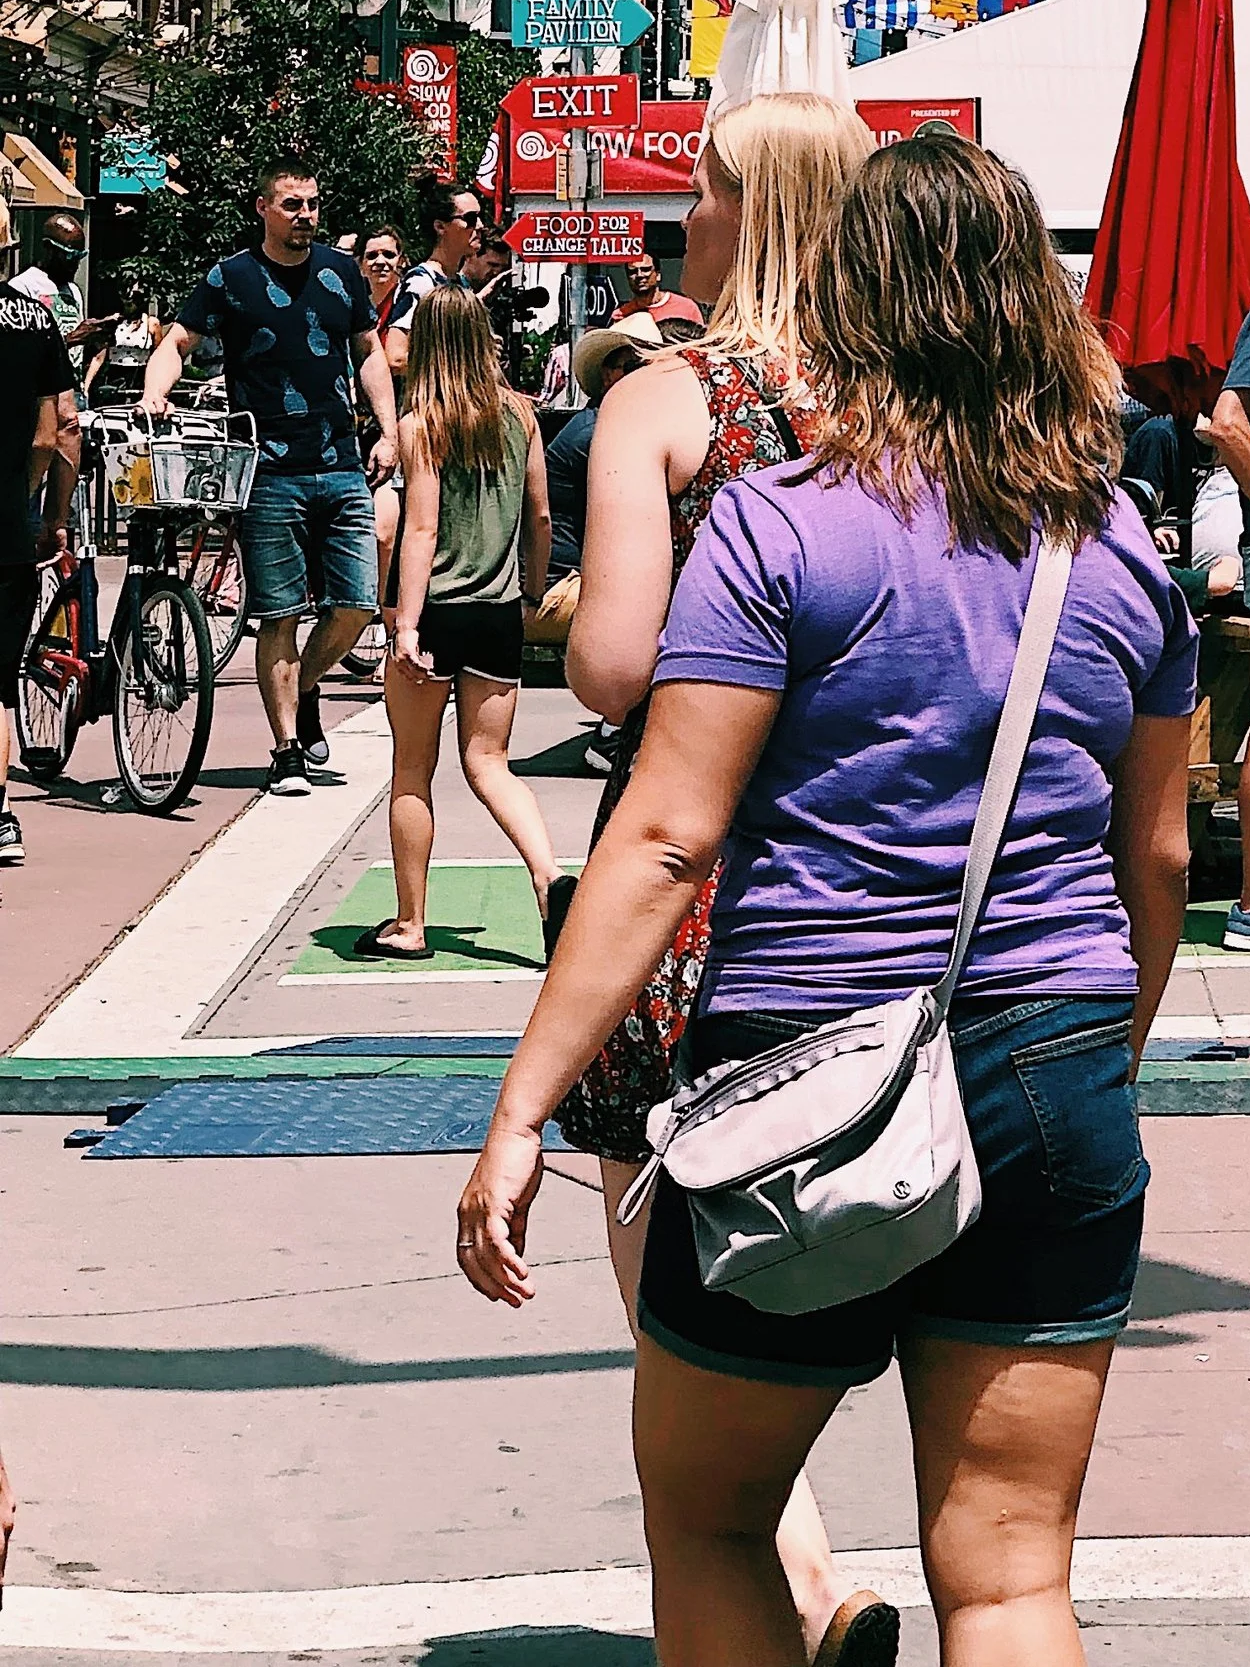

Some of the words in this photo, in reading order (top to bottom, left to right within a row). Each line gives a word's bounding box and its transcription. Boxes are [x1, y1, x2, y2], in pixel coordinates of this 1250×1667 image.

[525, 21, 622, 43] PAVILION
[408, 84, 451, 102] SLOW
[532, 85, 618, 118] EXIT
[535, 216, 594, 235] FOOD
[599, 216, 629, 231] FOR
[522, 237, 587, 252] CHANGE
[589, 237, 643, 256] TALKS
